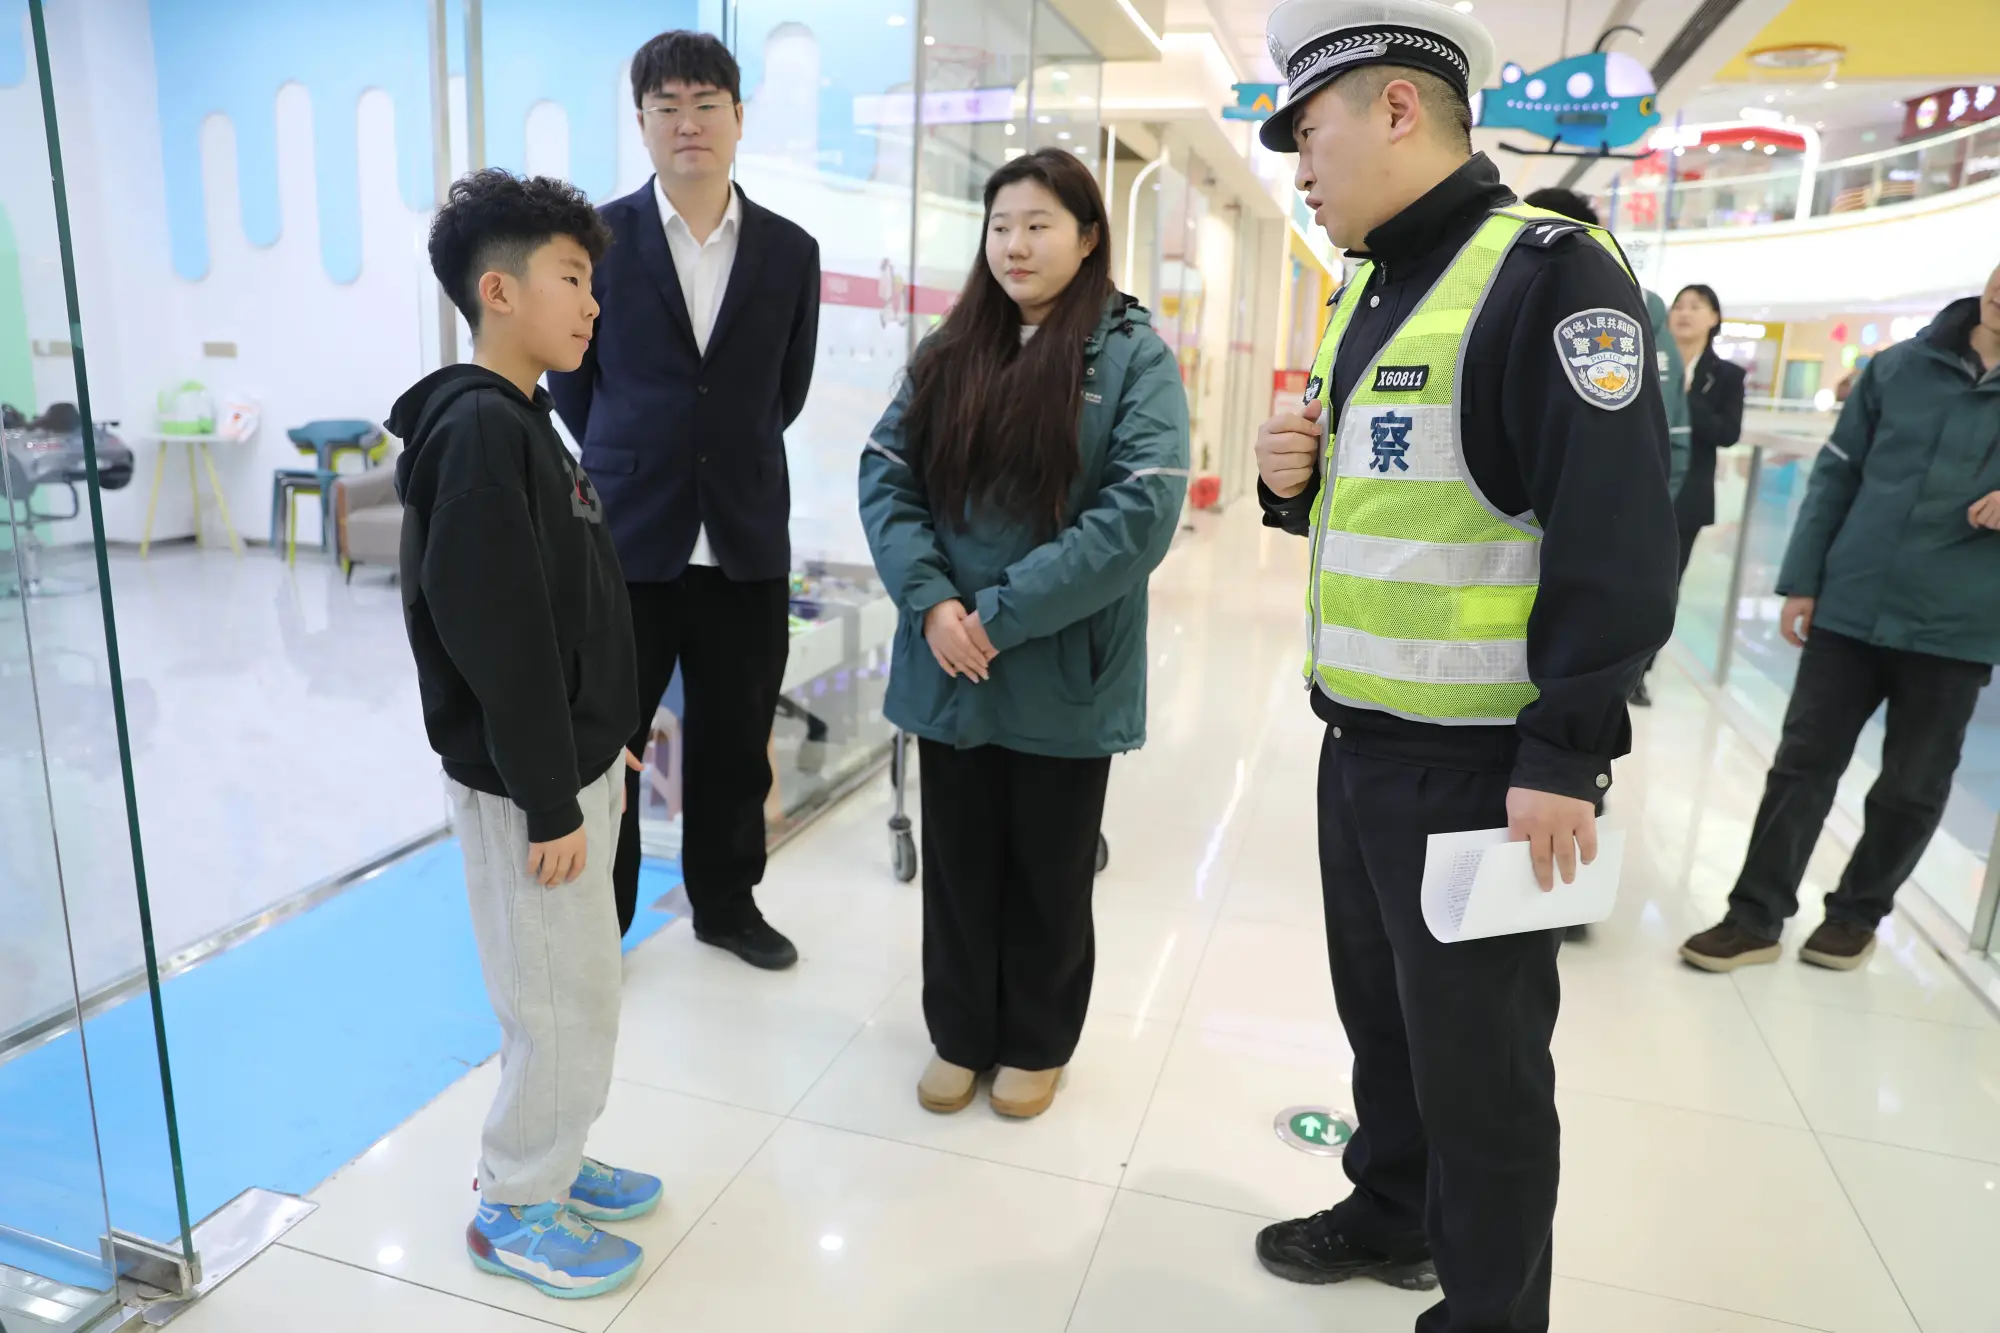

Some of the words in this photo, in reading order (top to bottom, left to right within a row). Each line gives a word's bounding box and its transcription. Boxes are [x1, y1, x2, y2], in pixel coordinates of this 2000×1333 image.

[1561, 316, 1636, 340] 中华人民共和国
[1572, 337, 1591, 355] 警
[1619, 337, 1635, 353] 察
[1590, 352, 1622, 363] POLICE
[1377, 371, 1423, 387] X60811
[1369, 410, 1413, 472] 察
